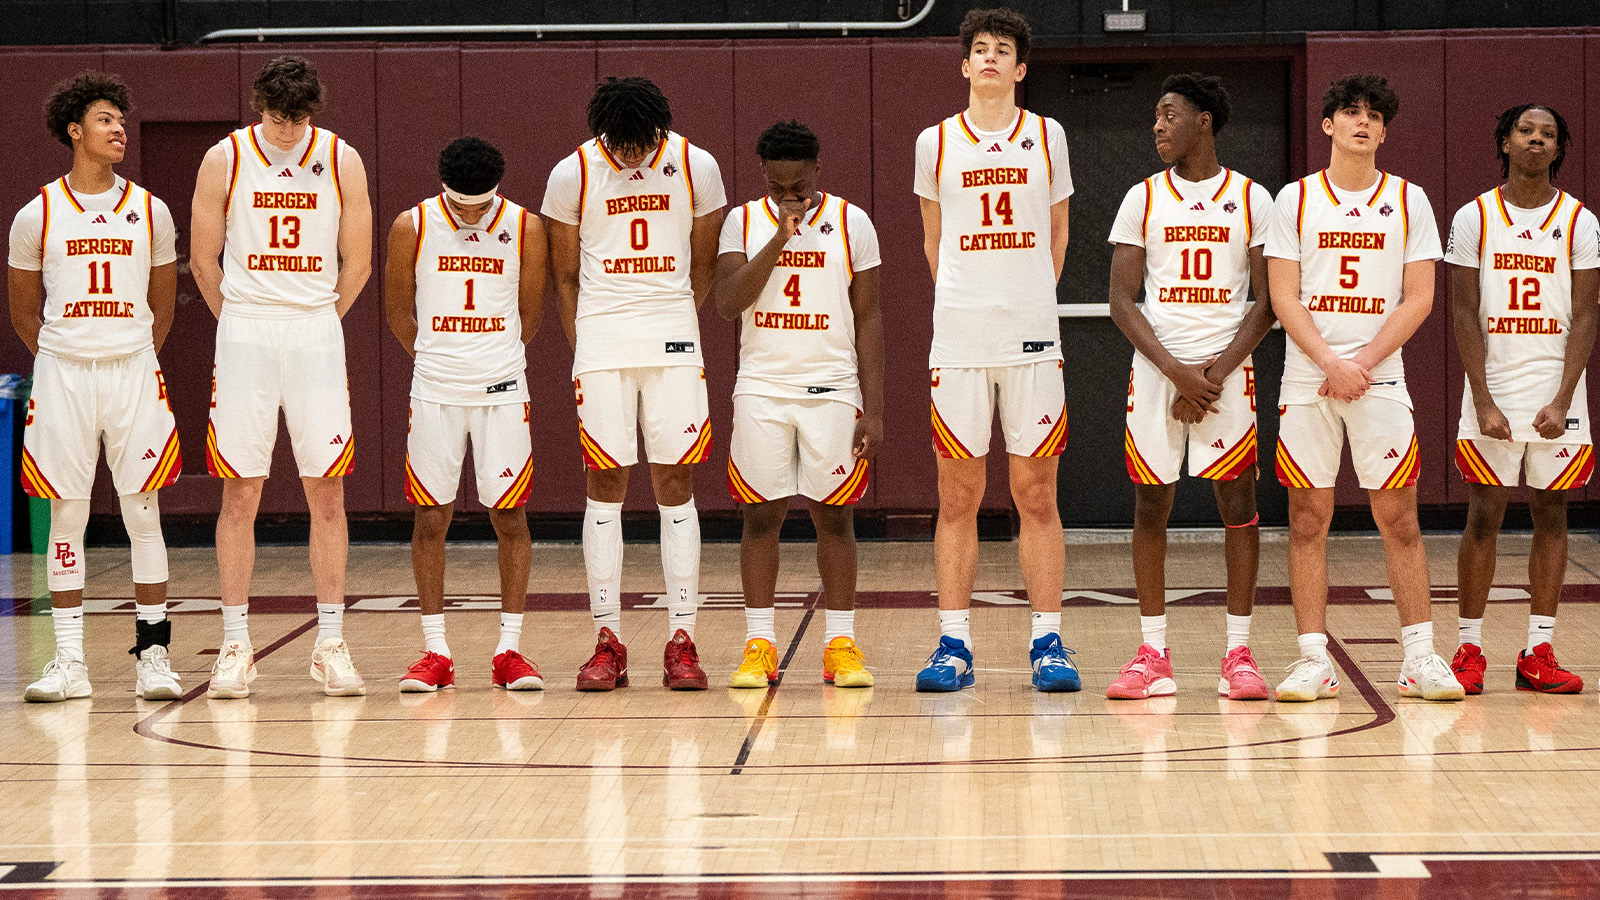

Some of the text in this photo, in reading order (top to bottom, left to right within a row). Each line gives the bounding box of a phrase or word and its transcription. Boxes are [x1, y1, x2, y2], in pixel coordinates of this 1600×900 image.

[961, 167, 1028, 188] BERGEN
[253, 191, 317, 207] BERGEN
[605, 194, 670, 216] BERGEN
[980, 191, 1013, 227] 14
[269, 215, 301, 249] 13
[630, 219, 649, 251] 0
[960, 232, 1035, 251] CATHOLIC
[1164, 226, 1230, 243] BERGEN
[1318, 232, 1386, 250] BERGEN
[65, 238, 133, 256] BERGEN
[248, 254, 322, 272] CATHOLIC
[438, 256, 504, 274] BERGEN
[603, 256, 675, 274] CATHOLIC
[1180, 248, 1212, 281] 10
[1339, 255, 1360, 289] 5
[1493, 253, 1556, 273] BERGEN
[88, 261, 113, 295] 11
[464, 278, 475, 311] 1
[783, 274, 801, 307] 4
[1159, 287, 1231, 304] CATHOLIC
[1508, 277, 1541, 311] 12
[63, 300, 134, 318] CATHOLIC
[1308, 295, 1386, 315] CATHOLIC
[432, 316, 505, 333] CATHOLIC
[754, 311, 830, 331] CATHOLIC
[1487, 316, 1563, 335] CATHOLIC
[55, 542, 76, 568] BC
